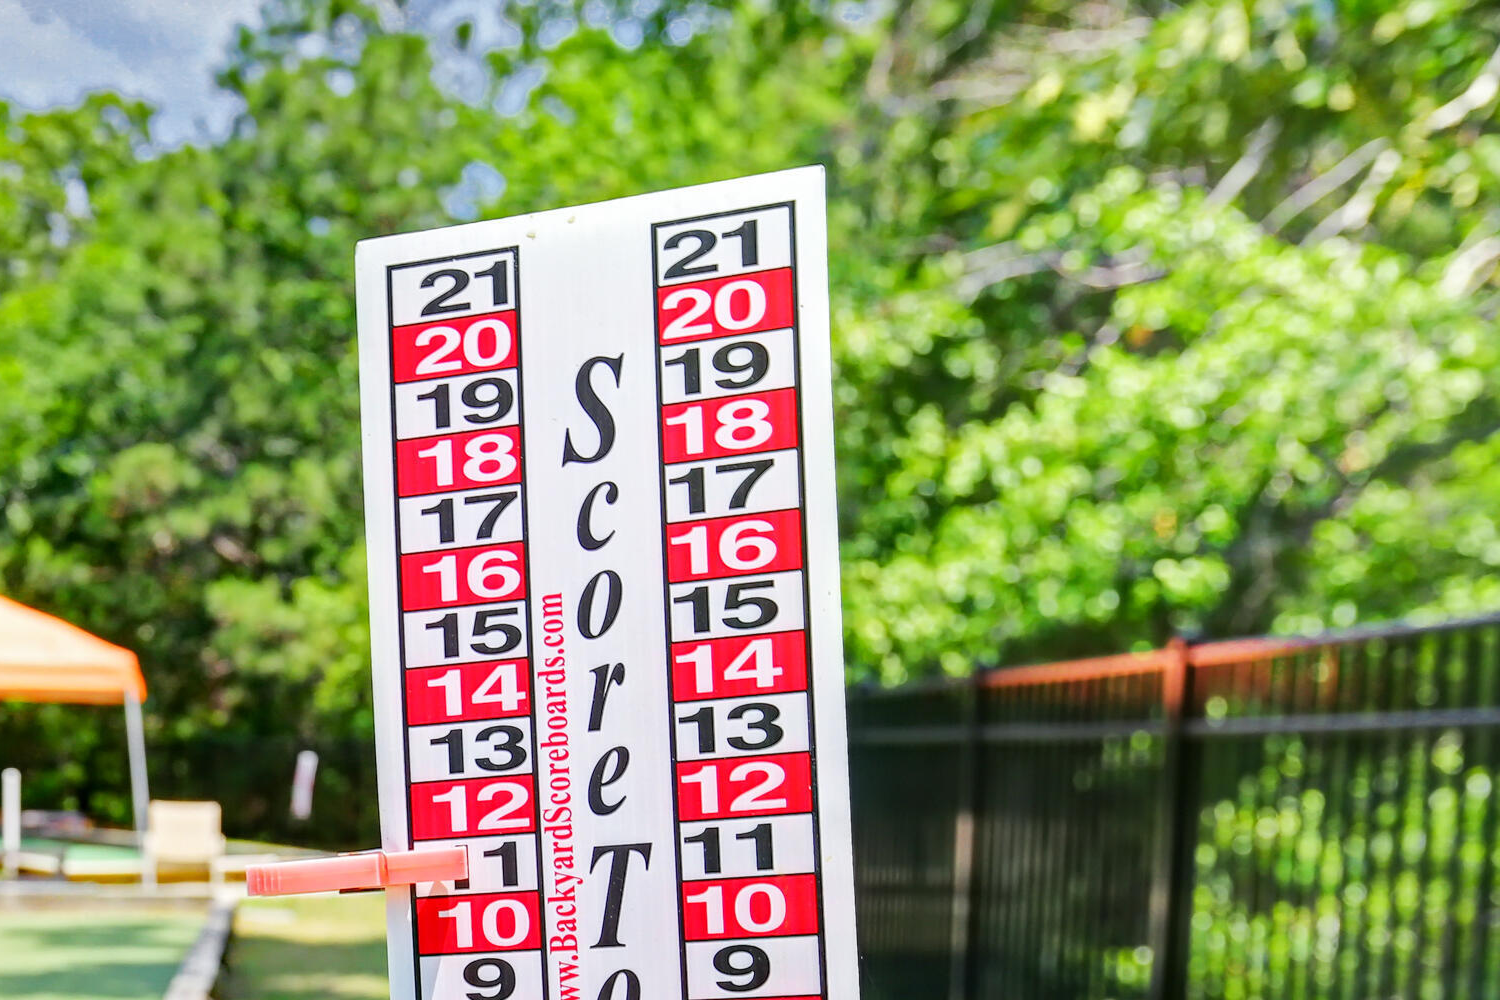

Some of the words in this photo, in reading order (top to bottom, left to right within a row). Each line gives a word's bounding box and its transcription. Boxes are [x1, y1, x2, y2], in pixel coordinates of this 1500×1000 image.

[663, 219, 758, 280] 21
[420, 260, 508, 317] 21
[662, 279, 767, 340] 20
[415, 319, 512, 375] 20
[664, 341, 769, 396] 19
[417, 377, 514, 430] 19
[665, 399, 773, 455] 18
[418, 433, 517, 487] 18
[668, 458, 774, 515] 17
[421, 491, 518, 545] 17
[670, 519, 777, 575] 16
[422, 550, 521, 602] 16
[425, 607, 522, 659] 15
[673, 579, 779, 634] 15
[427, 663, 527, 717] 14
[675, 638, 783, 694] 14
[430, 725, 527, 775] 13
[678, 702, 784, 755] 13
[432, 782, 530, 833] 12
[680, 761, 787, 814] 12
[683, 823, 774, 875] 11
[438, 899, 530, 948] 10
[686, 883, 787, 935] 10
[712, 944, 771, 993] 9
